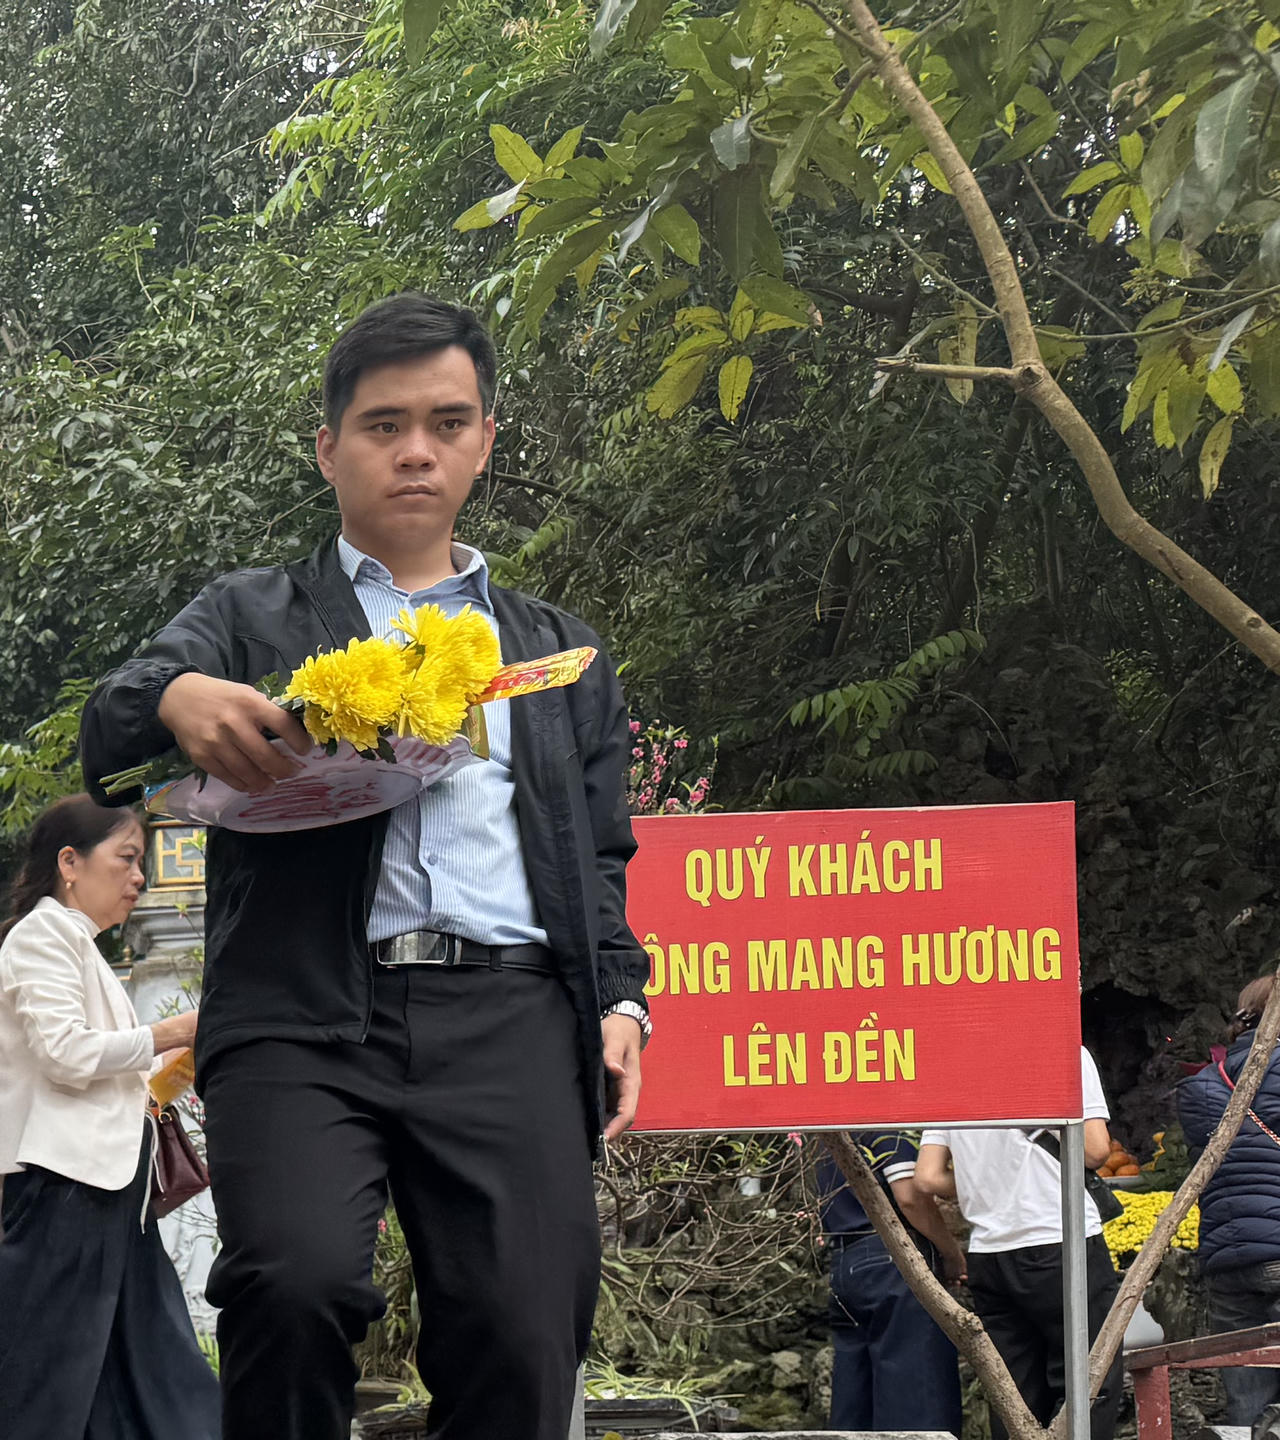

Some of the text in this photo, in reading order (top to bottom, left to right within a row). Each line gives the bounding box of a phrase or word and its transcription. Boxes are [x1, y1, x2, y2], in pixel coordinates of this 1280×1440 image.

[685, 830, 943, 907] QUÝ KHÁCH
[642, 925, 1062, 996] ÔNG MANG HƯƠNG
[722, 1011, 916, 1087] LÊN ĐỀN
